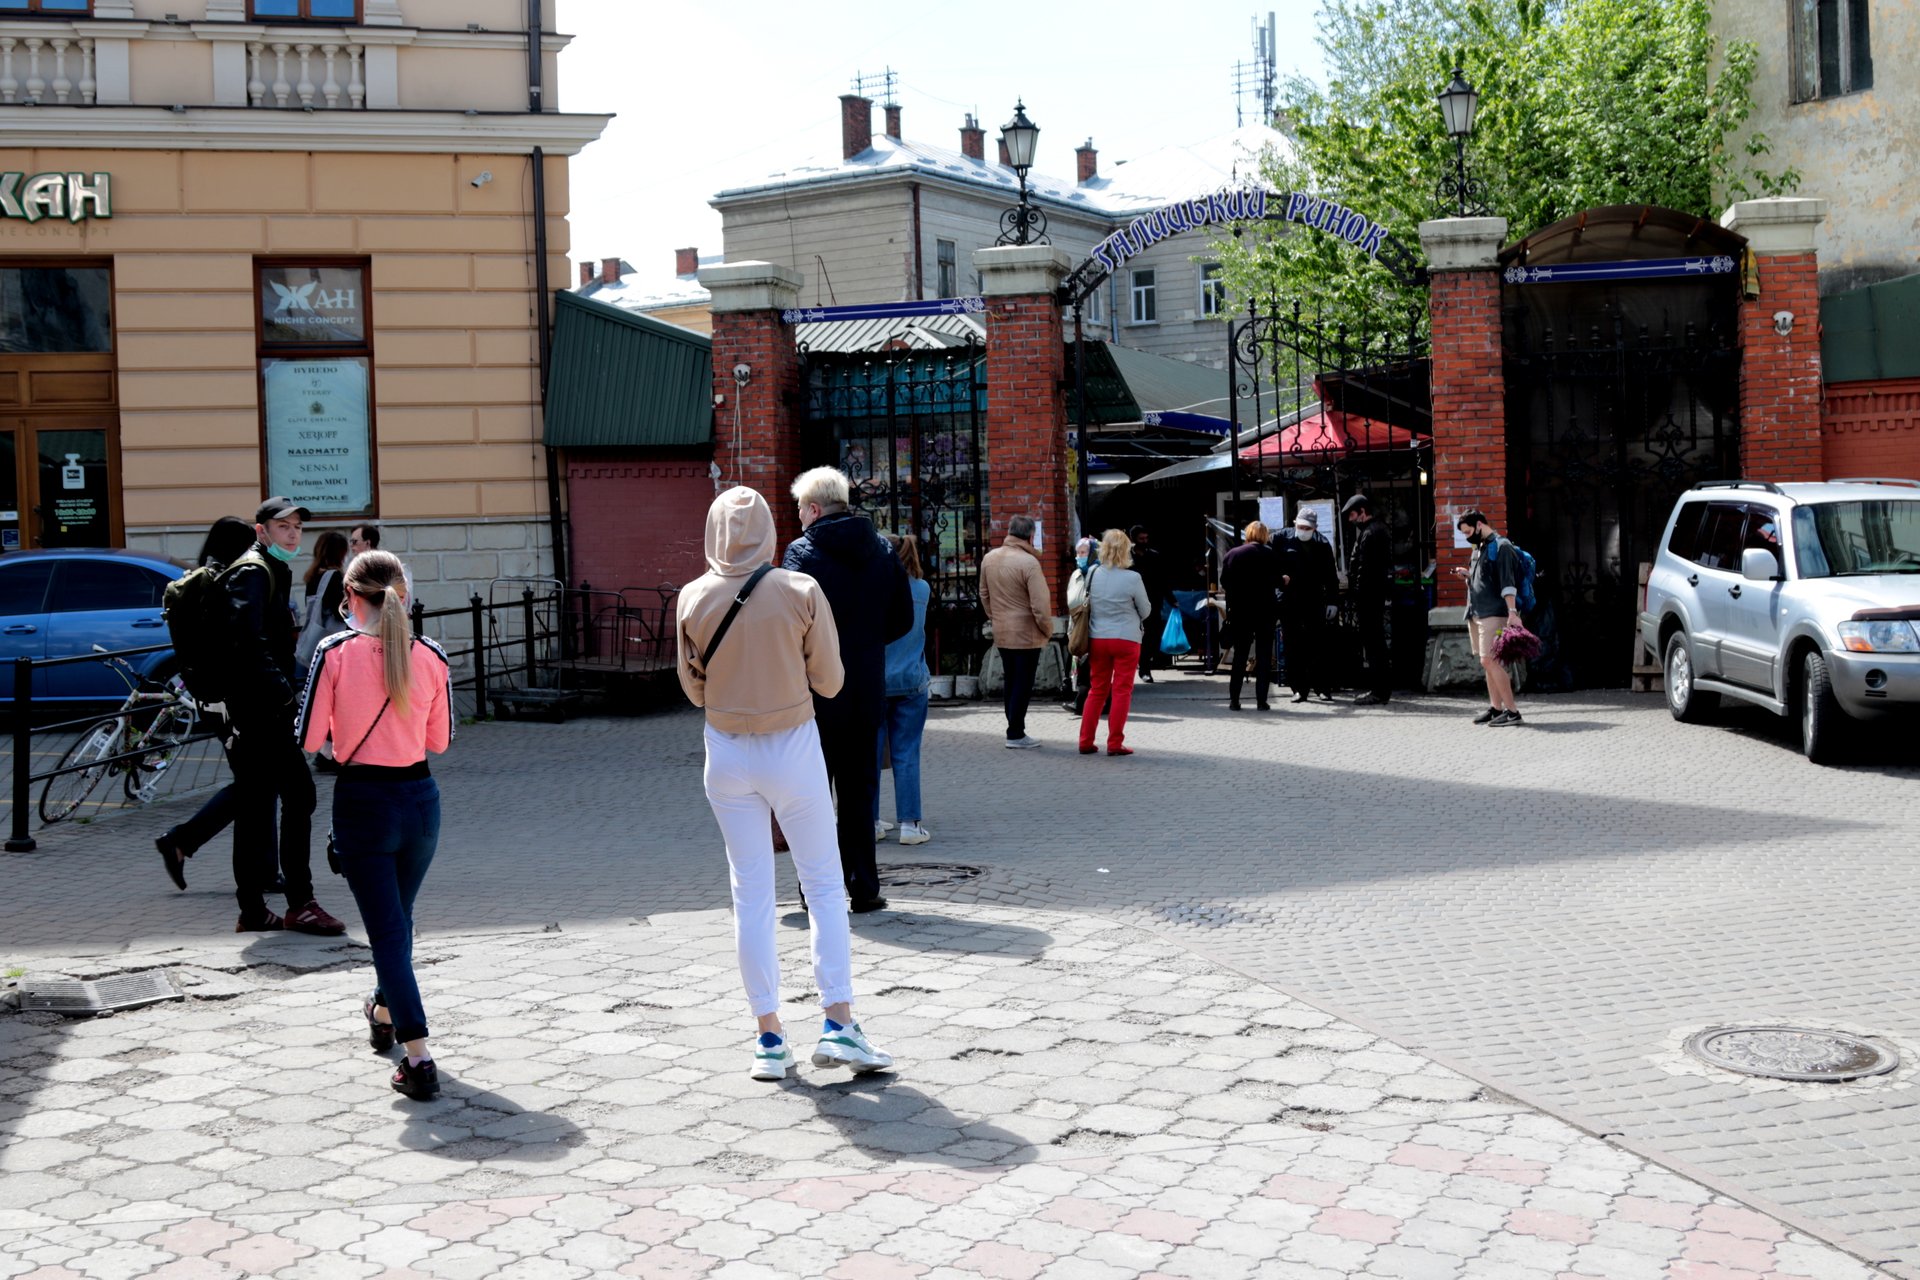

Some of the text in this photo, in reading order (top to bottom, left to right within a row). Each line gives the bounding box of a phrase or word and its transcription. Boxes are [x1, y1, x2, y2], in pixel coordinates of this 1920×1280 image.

[1286, 191, 1388, 259] РИНОК
[25, 226, 111, 237] CONCEPT
[269, 280, 355, 313] ЖАН
[274, 316, 355, 325] NICHE CONCEPT
[299, 431, 338, 440] XERJOFF
[300, 464, 339, 472] SENSAI
